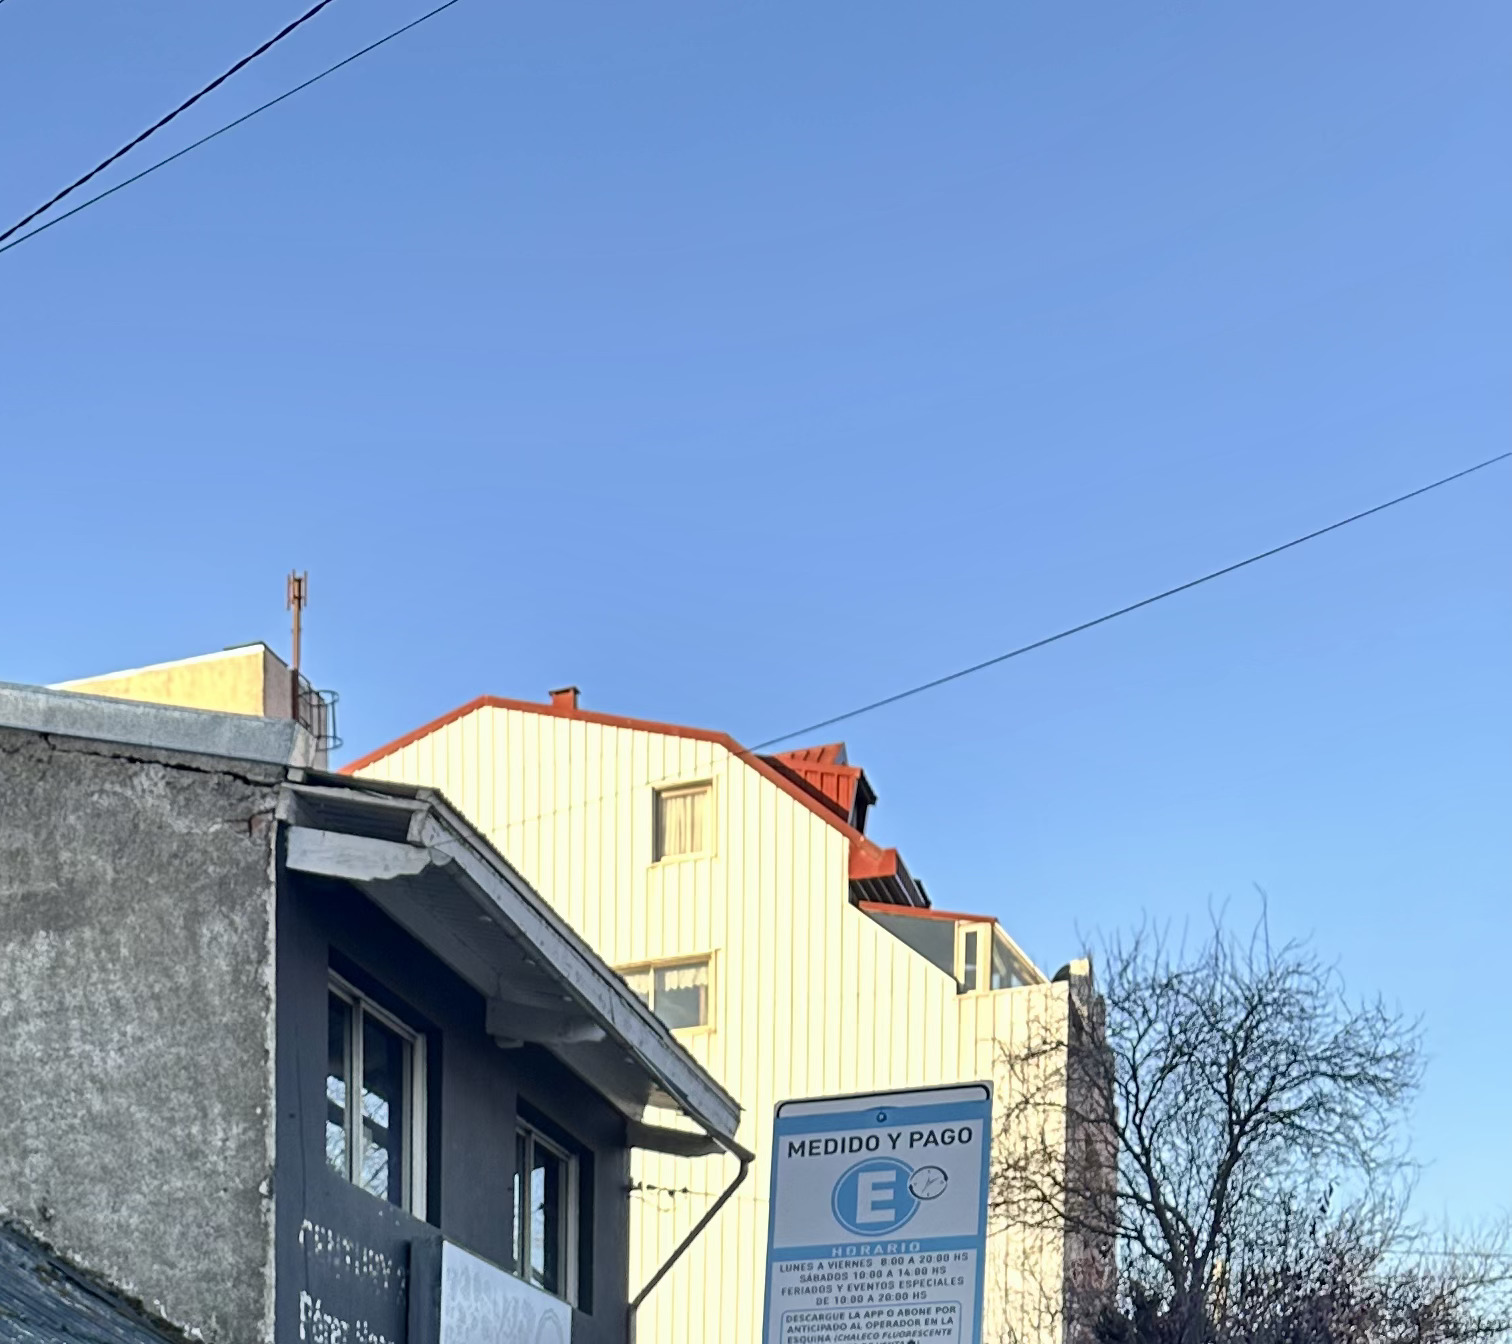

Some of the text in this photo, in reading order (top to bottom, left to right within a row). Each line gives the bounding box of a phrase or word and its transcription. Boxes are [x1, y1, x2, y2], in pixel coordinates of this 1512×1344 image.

[788, 1126, 973, 1158] MEDIDO Y PAGO
[855, 1169, 897, 1224] E
[832, 1241, 920, 1257] HORARIO
[780, 1262, 814, 1273] LUNES
[817, 1261, 824, 1270] A
[828, 1259, 873, 1270] VIERNES
[908, 1256, 915, 1264] A
[954, 1252, 968, 1262] HS
[800, 1271, 848, 1283] SÁBADOS
[886, 1269, 893, 1278] A
[932, 1265, 947, 1275] HS
[781, 1276, 964, 1296] FERIADOS Y EVENTOS ESPECIALES
[816, 1296, 829, 1306] DE
[867, 1294, 874, 1302] A
[912, 1290, 928, 1300] HS
[786, 1311, 845, 1323] DESCARGUE
[849, 1311, 860, 1320] LA
[864, 1309, 884, 1319] APP
[897, 1306, 931, 1317] ABONE
[935, 1305, 956, 1315] POR
[787, 1316, 954, 1334] ANTICIPADO AL OPERADOR EN LA
[787, 1328, 953, 1344] ESQUINA (CHALECO FLUORESCENTE
